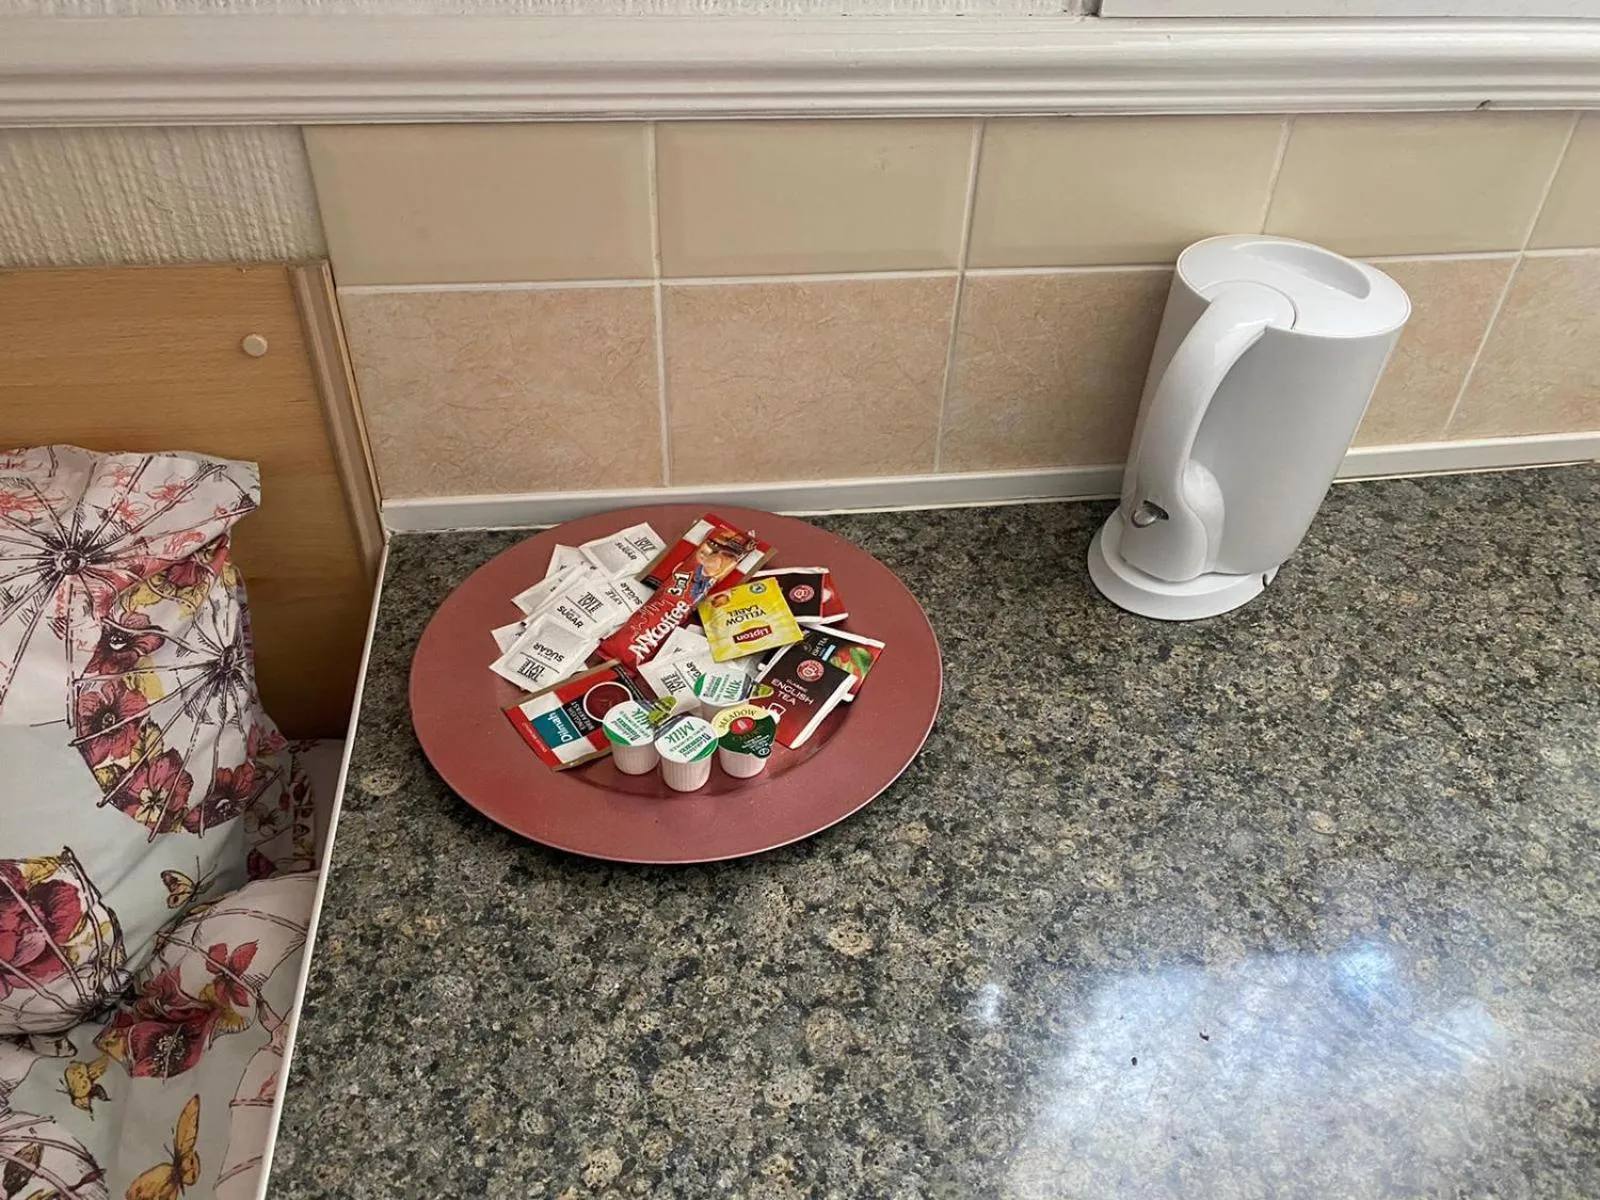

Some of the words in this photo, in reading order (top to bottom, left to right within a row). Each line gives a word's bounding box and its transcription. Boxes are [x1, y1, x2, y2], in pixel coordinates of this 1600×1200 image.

[620, 582, 642, 605] SUGAR
[556, 605, 584, 629] SUGAR
[726, 609, 766, 626] YELLOW
[727, 604, 759, 617] LABEL
[736, 628, 769, 641] Lipton
[532, 642, 565, 663] SUGAR
[686, 661, 702, 678] GAR
[723, 680, 742, 700] Milk
[771, 678, 815, 705] ENGLISH
[777, 690, 796, 706] TEA
[547, 711, 573, 743] Dilmah
[718, 709, 757, 728] MEADOW
[664, 721, 694, 744] Milk
